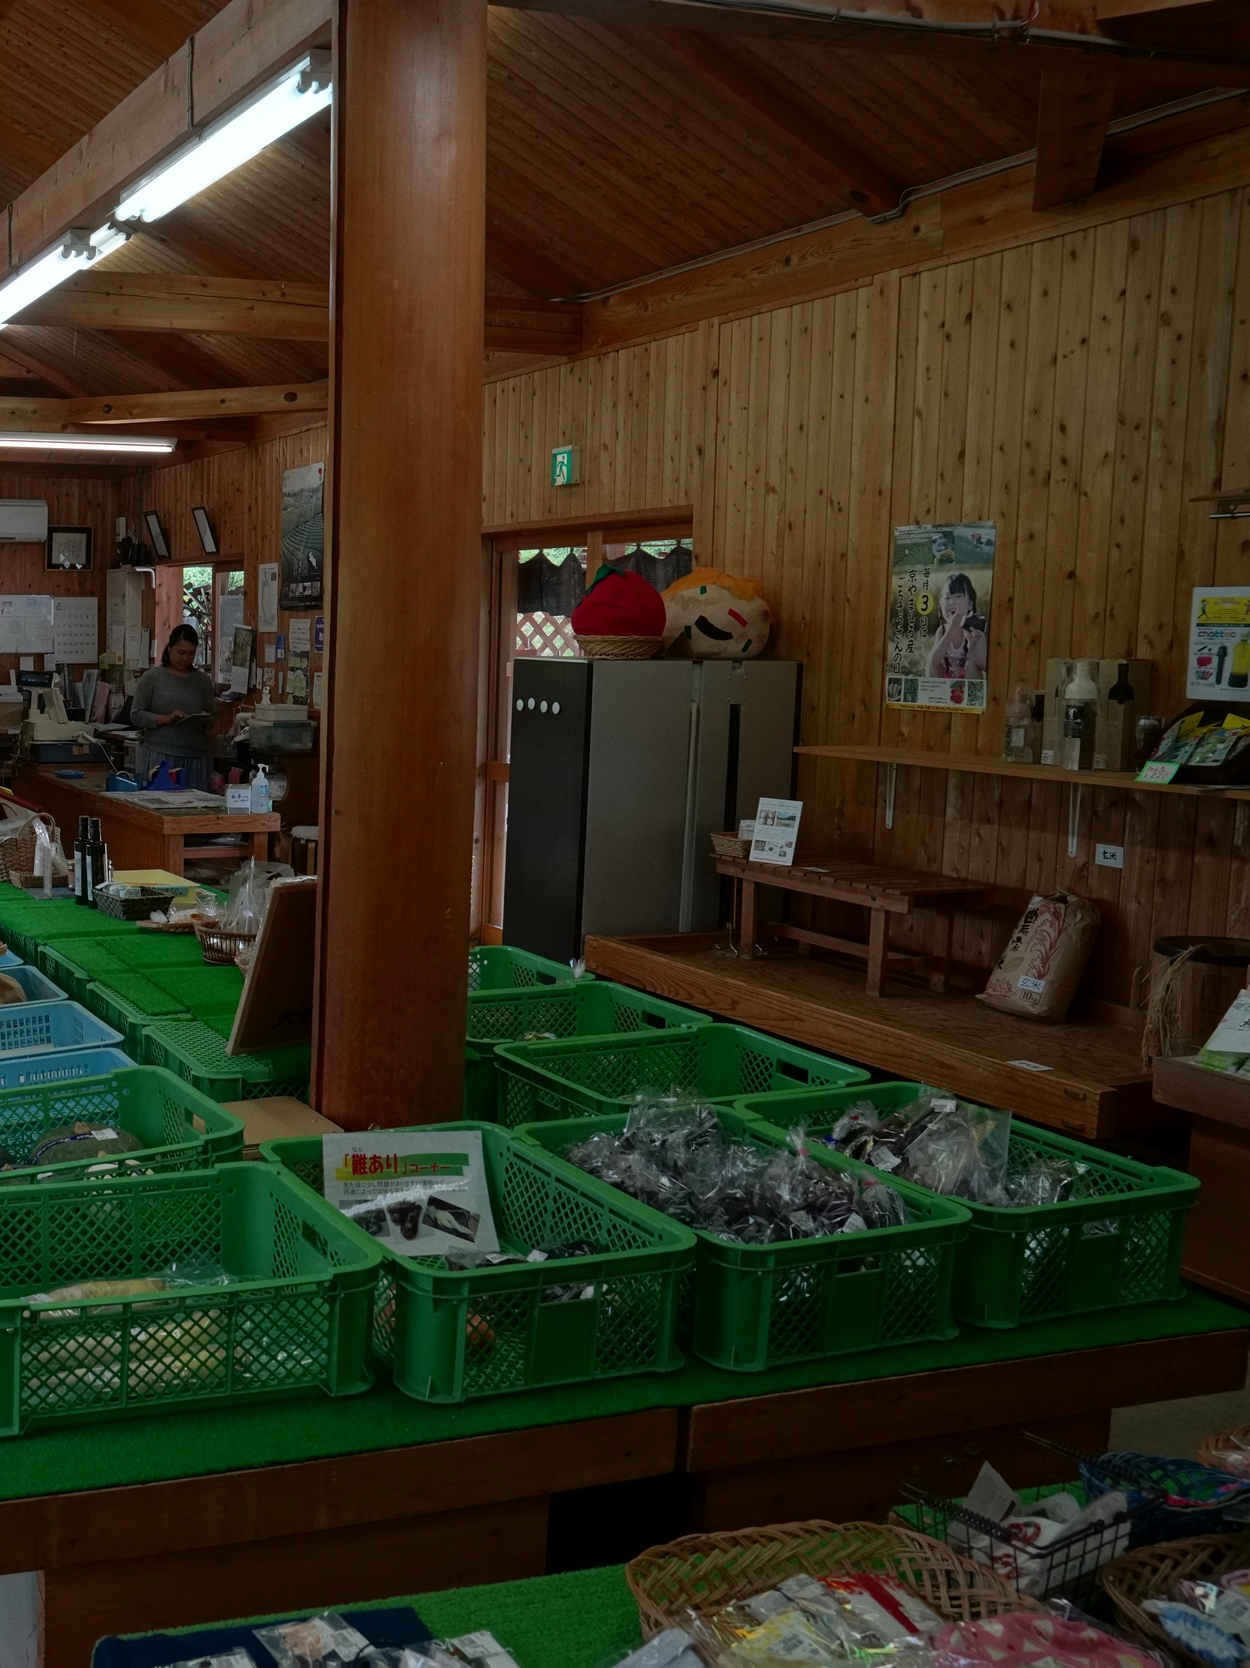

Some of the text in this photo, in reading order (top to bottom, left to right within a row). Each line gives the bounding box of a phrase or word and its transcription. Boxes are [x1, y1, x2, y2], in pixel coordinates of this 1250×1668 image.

[893, 576, 906, 674] ごちそうさんの日
[905, 568, 918, 654] 京やましろ産
[920, 567, 932, 639] 毎月3日は
[1020, 977, 1042, 990] 玄米
